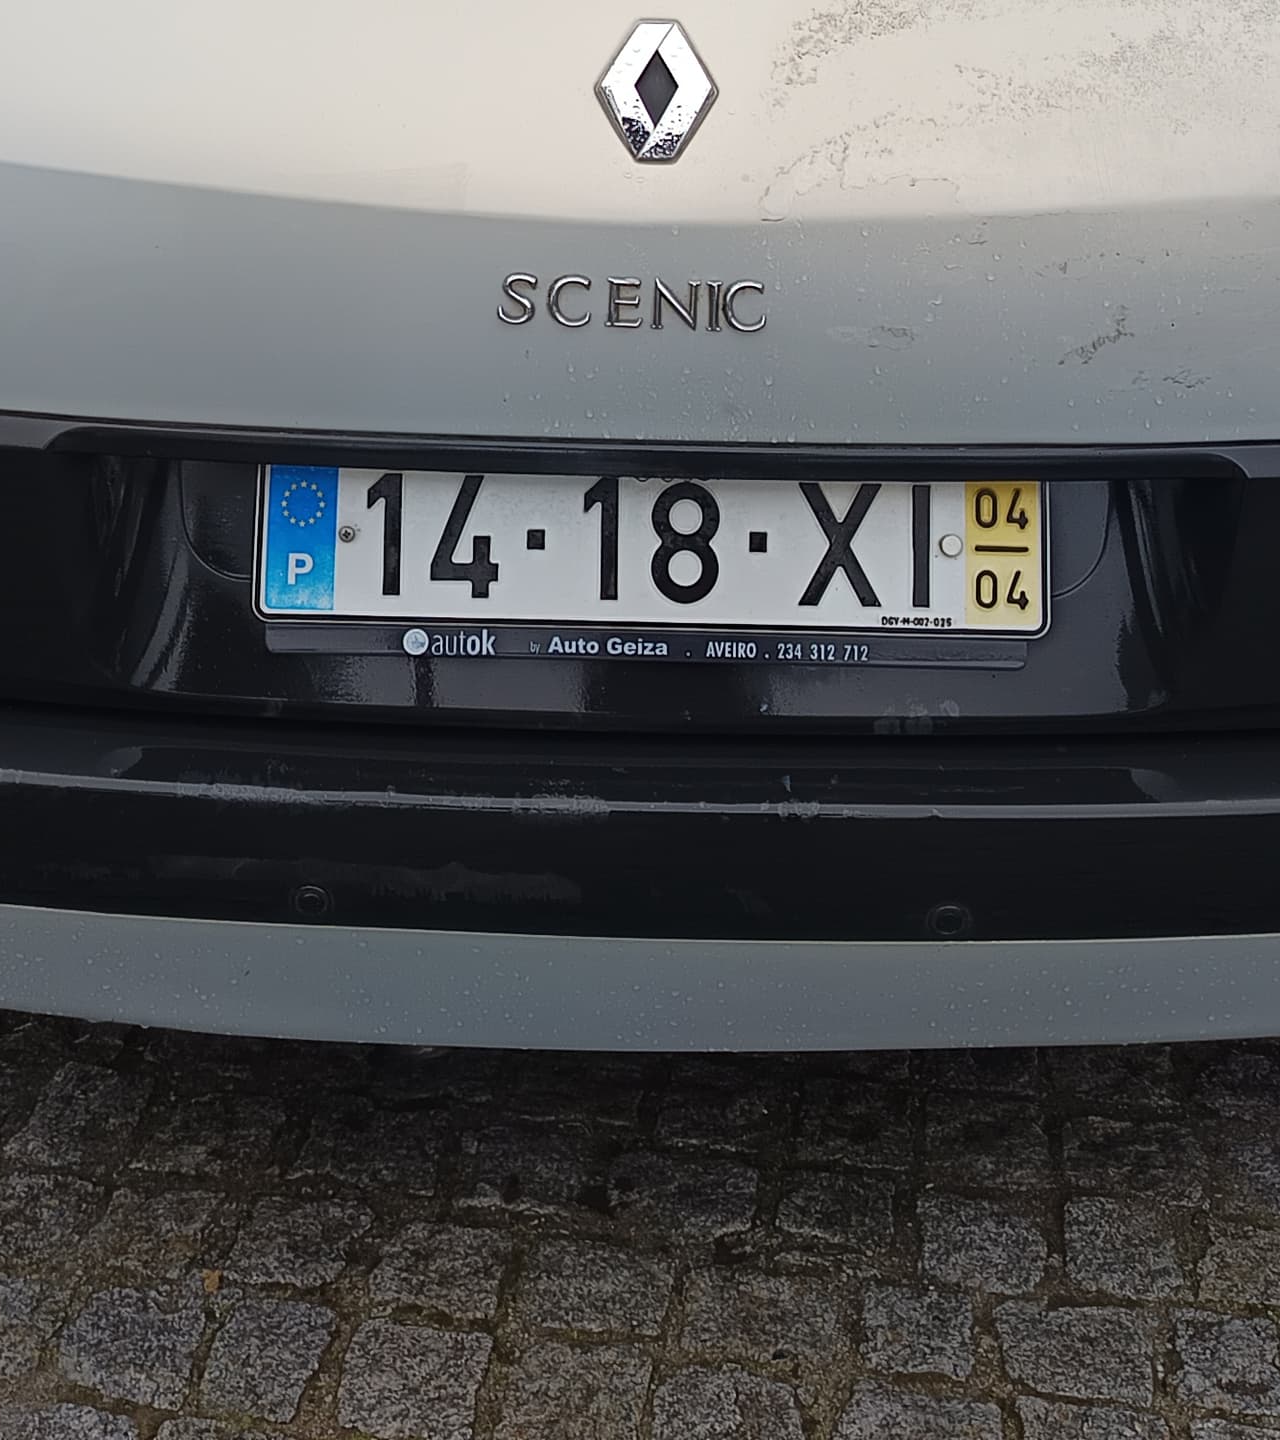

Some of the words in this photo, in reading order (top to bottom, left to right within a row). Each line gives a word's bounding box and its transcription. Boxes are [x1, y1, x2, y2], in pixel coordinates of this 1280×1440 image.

[497, 272, 767, 332] SCENIC
[975, 488, 1028, 530] 04
[287, 552, 315, 585] P
[975, 569, 1029, 610] 04
[431, 628, 496, 656] autok
[529, 640, 541, 655] by
[547, 635, 600, 655] Auto
[606, 636, 668, 656] Geiza
[706, 641, 757, 658] AVEIRO
[777, 643, 802, 660] 234
[810, 644, 835, 660] 312
[843, 645, 869, 661] 712
